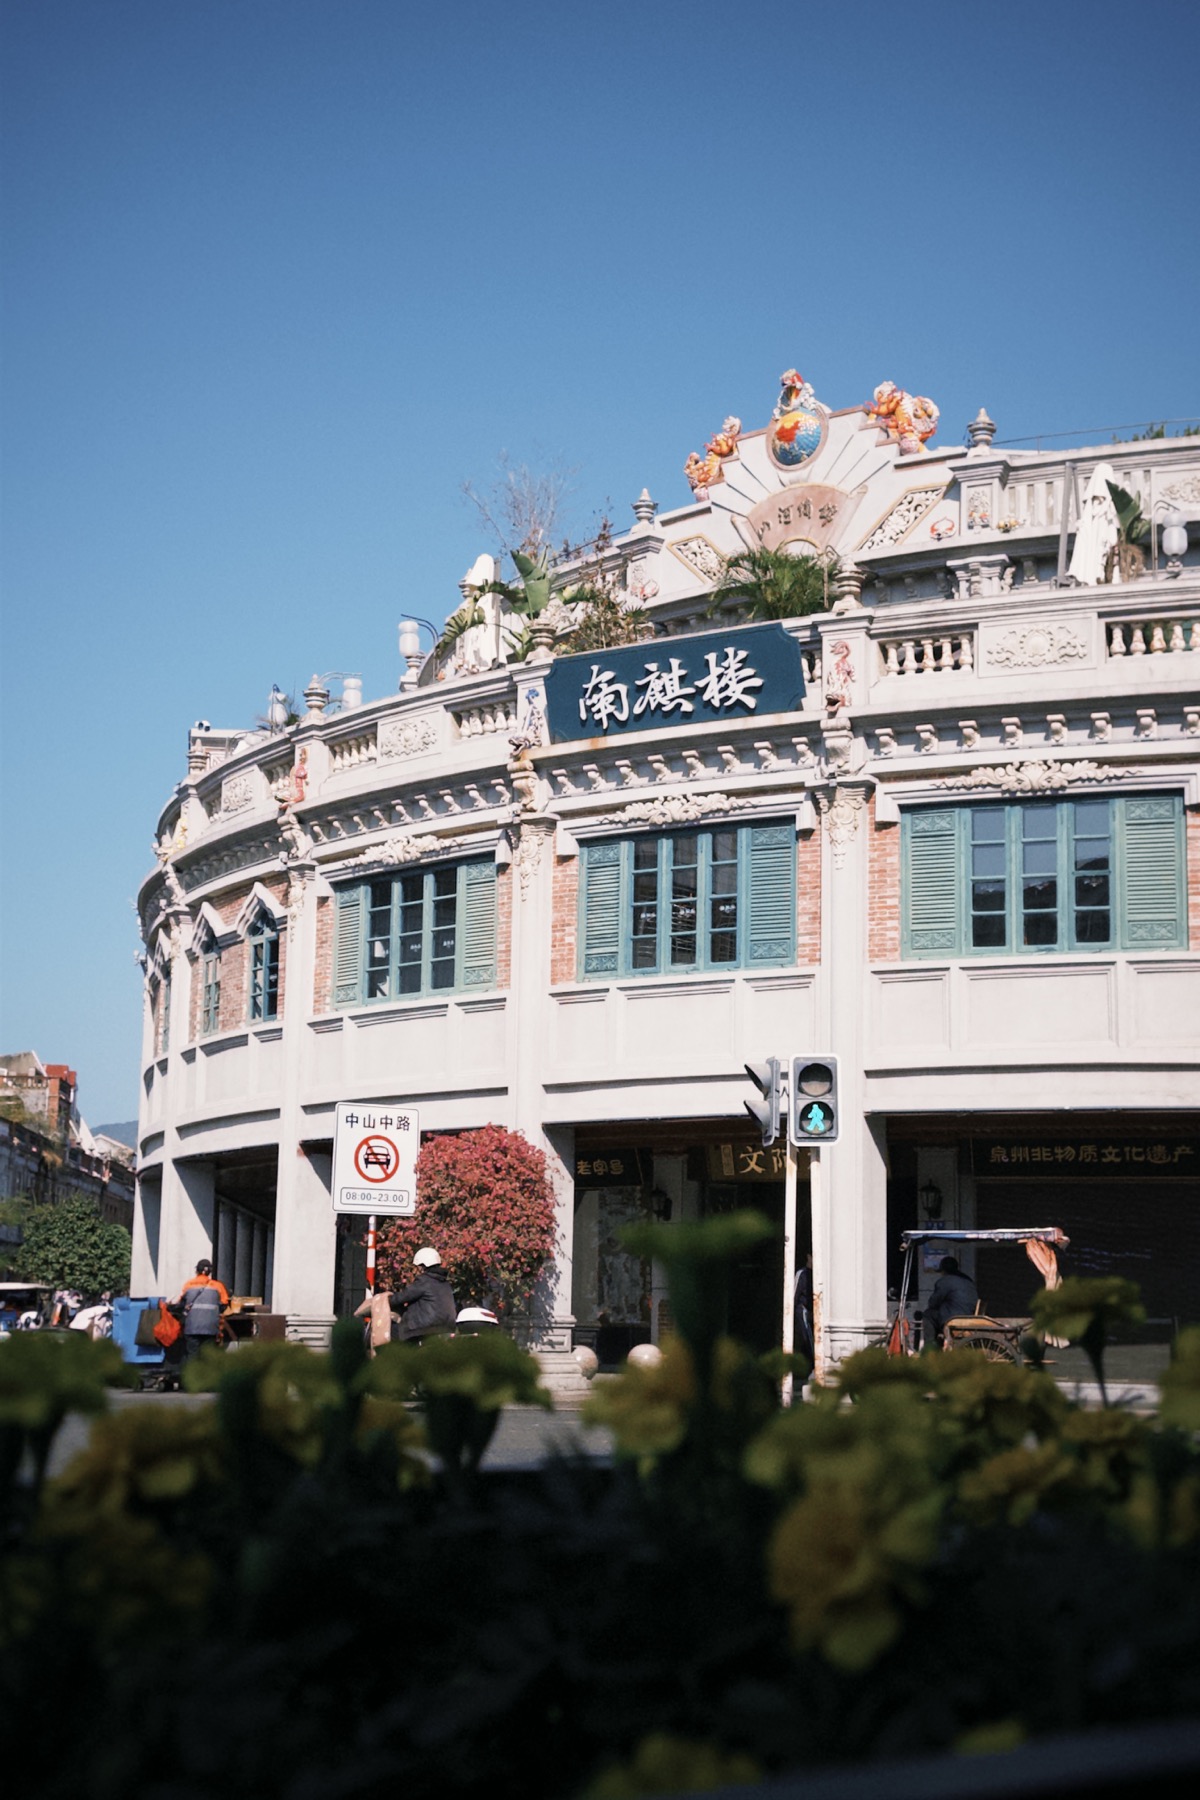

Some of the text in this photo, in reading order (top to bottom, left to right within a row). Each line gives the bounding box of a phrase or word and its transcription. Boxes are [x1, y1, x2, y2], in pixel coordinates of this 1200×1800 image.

[579, 646, 764, 730] 南麒楼
[345, 1112, 411, 1131] 中山中路
[990, 1145, 1195, 1165] 泉州非物质文化遗产
[577, 1159, 624, 1175] 老字号
[345, 1191, 404, 1203] 08:00-23:00
